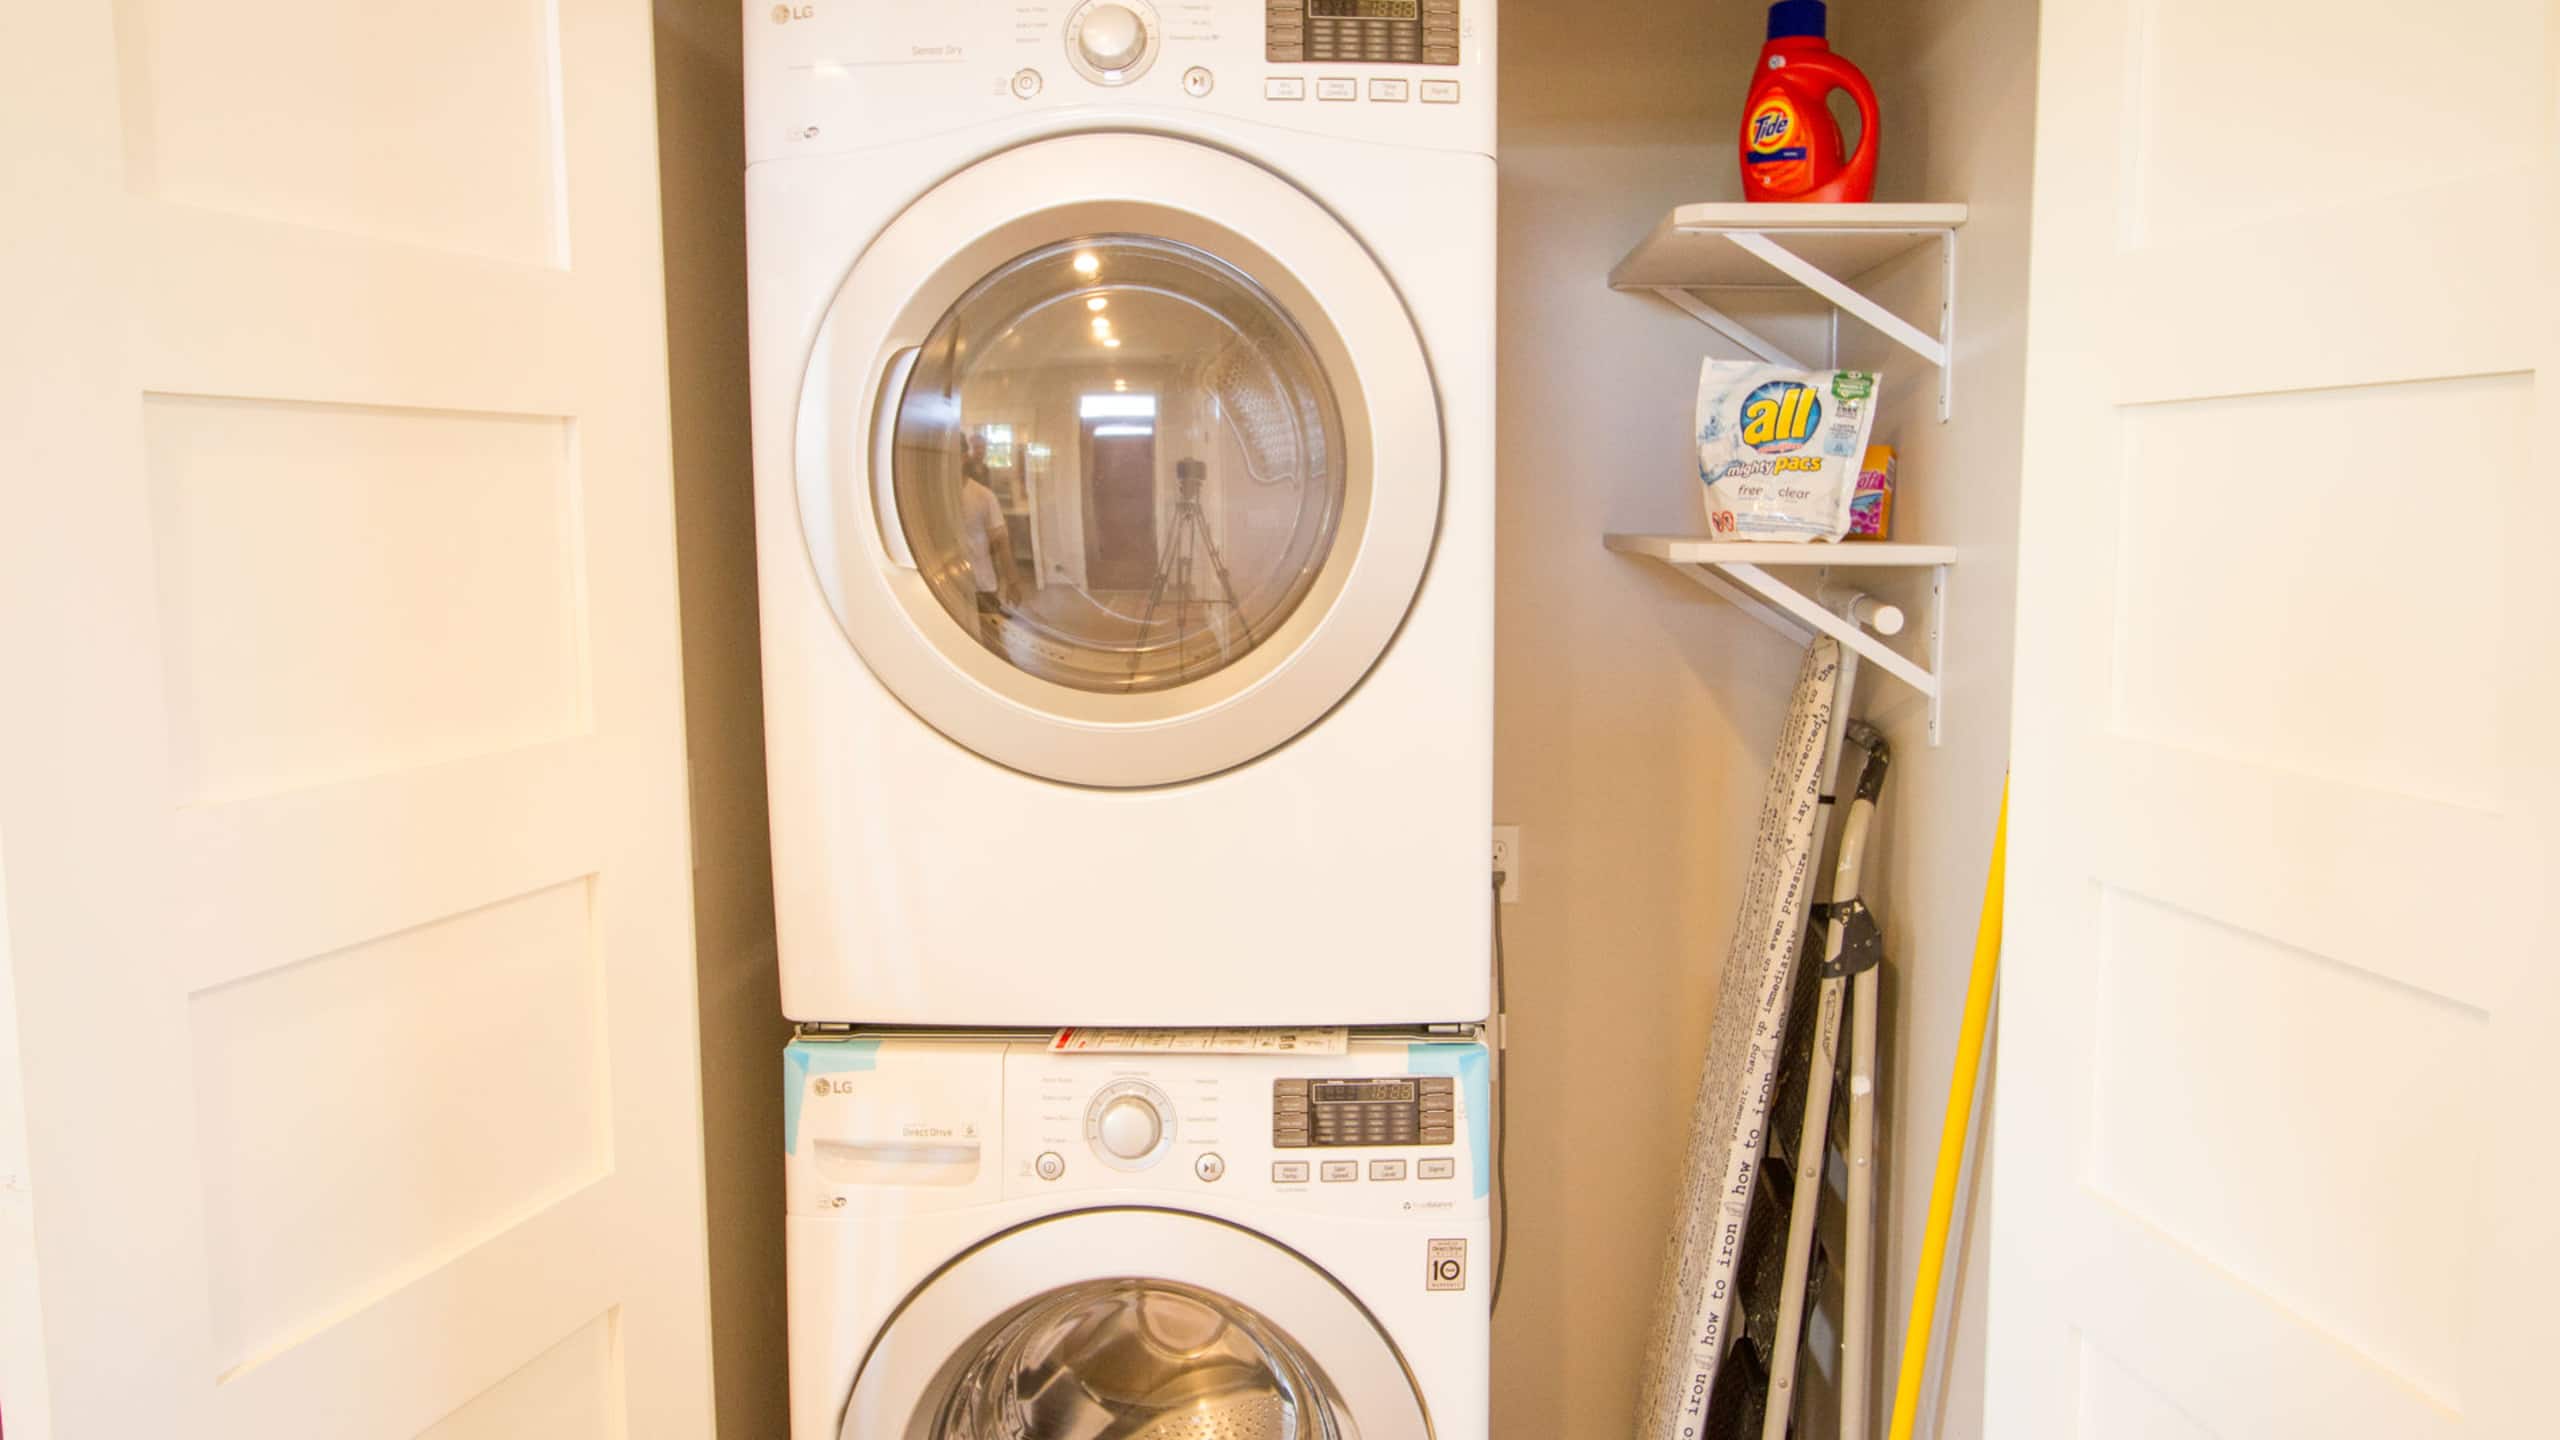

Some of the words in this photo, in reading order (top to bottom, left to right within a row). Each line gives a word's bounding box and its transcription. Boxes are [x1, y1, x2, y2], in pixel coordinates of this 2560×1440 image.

[793, 7, 813, 20] LG
[1753, 113, 1788, 144] Tide
[1743, 387, 1818, 445] all
[1728, 460, 1774, 479] mighty
[1774, 457, 1821, 475] pacs
[1738, 484, 1763, 496] free
[1778, 486, 1811, 500] clear
[1818, 663, 1836, 682] the
[1793, 800, 1811, 824] lay
[1770, 920, 1784, 951] even
[1784, 852, 1807, 916] pressure
[1747, 1044, 1760, 1075] hang
[1756, 1021, 1767, 1037] up
[833, 1082, 853, 1094] LG
[930, 1128, 952, 1137] Drive
[1690, 1373, 1706, 1417] iron
[1701, 1311, 1720, 1346] how
[1713, 1280, 1726, 1301] to
[1721, 1222, 1738, 1268] iron
[1732, 1161, 1752, 1196] how
[1744, 1128, 1760, 1149] to
[1754, 1071, 1773, 1116] iron
[1433, 1260, 1460, 1280] 10
